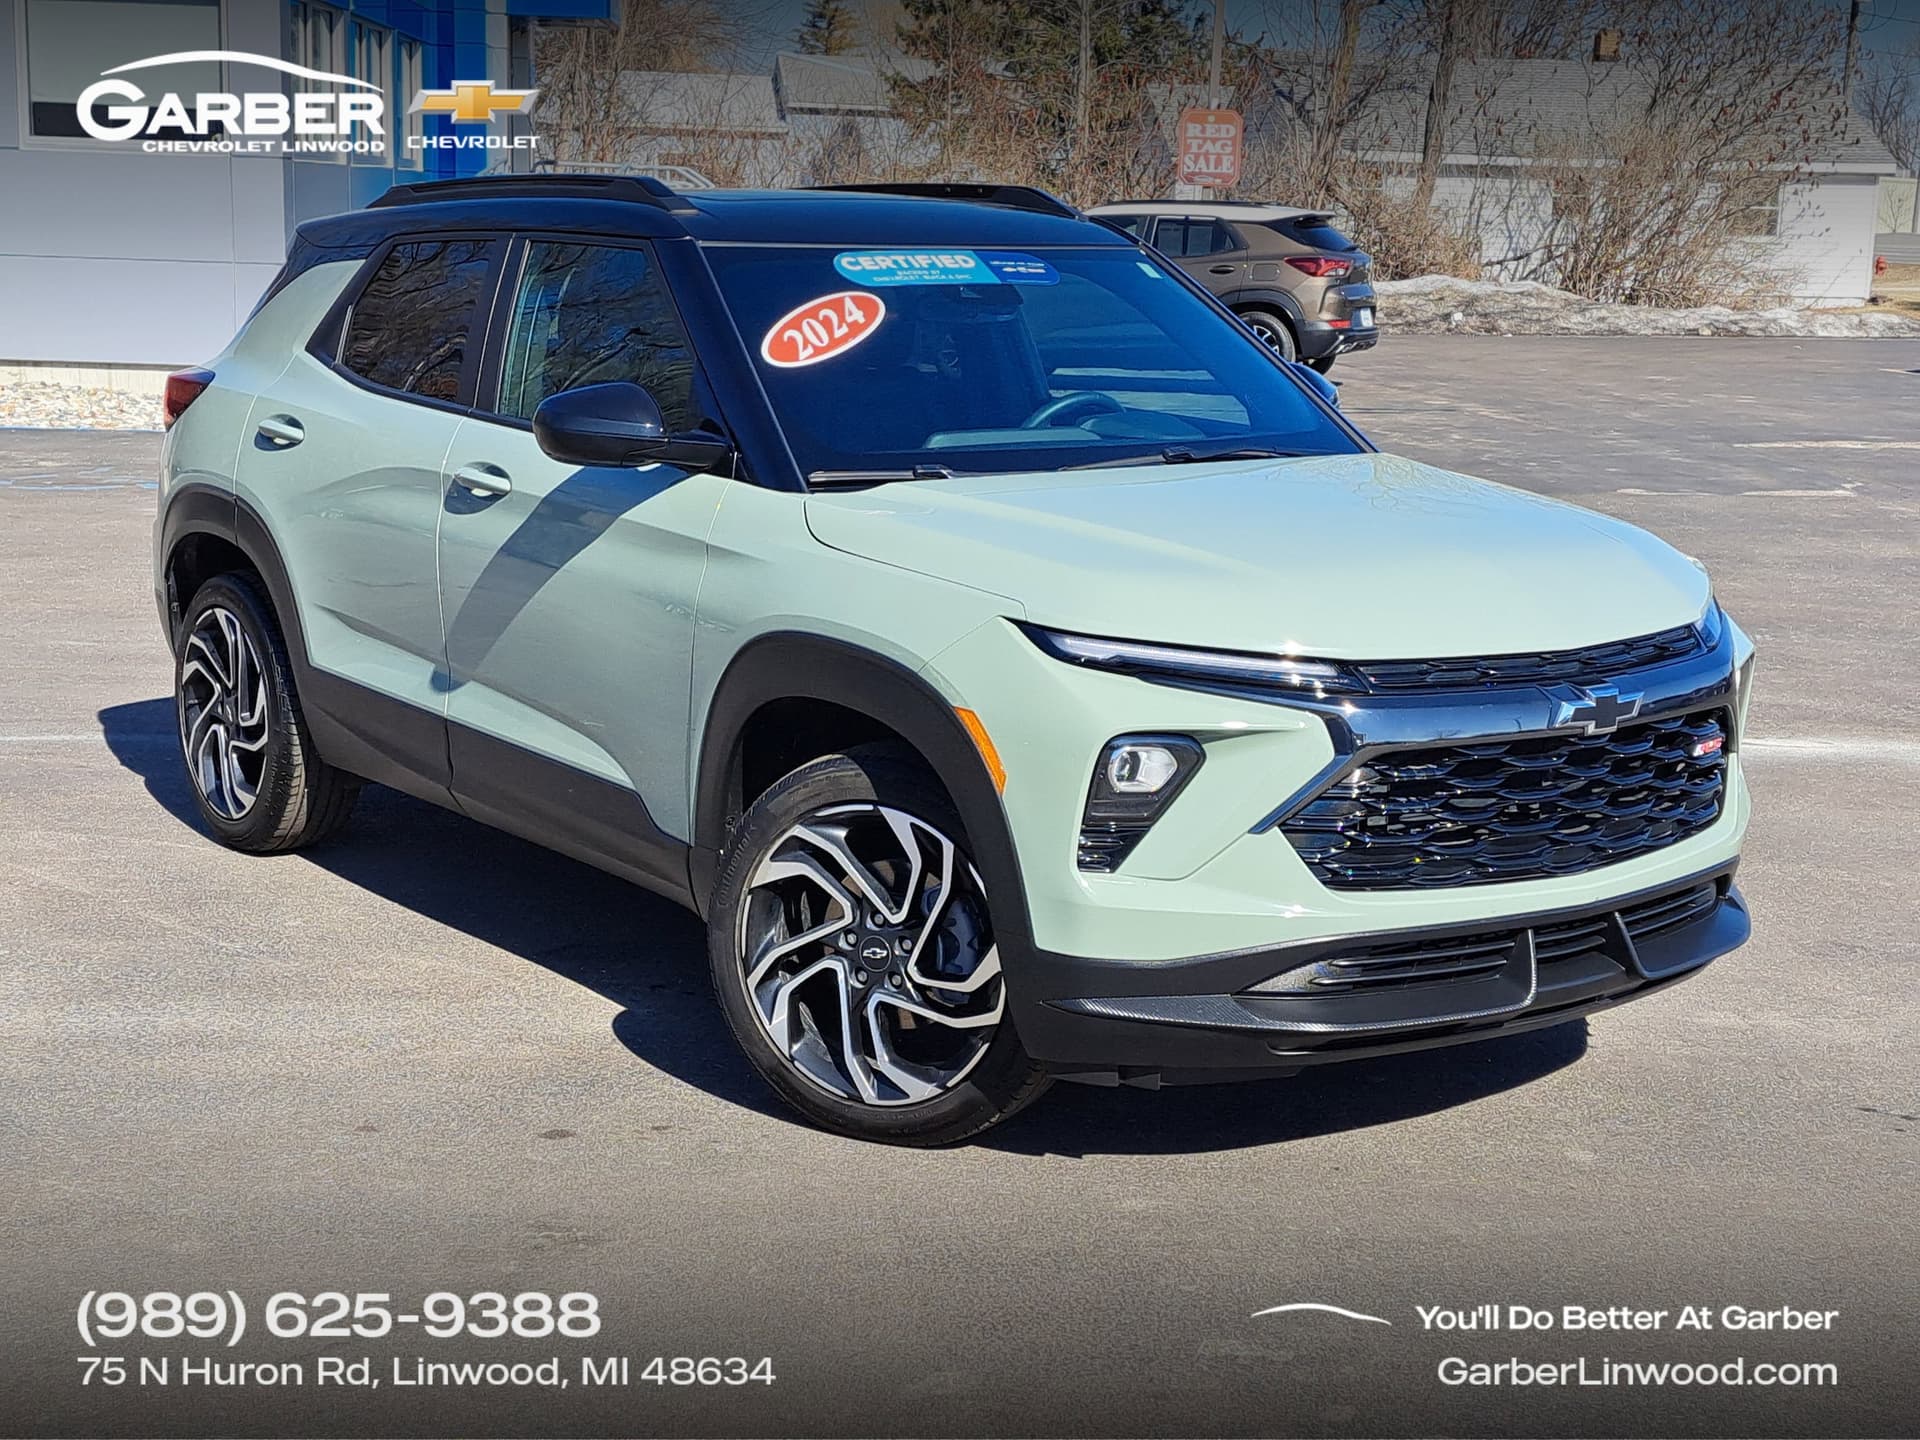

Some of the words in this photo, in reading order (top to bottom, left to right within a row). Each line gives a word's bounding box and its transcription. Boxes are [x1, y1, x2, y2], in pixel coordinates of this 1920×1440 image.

[1186, 124, 1236, 137] RED
[1187, 139, 1232, 153] TAG
[1183, 154, 1234, 173] SALE
[840, 254, 976, 271] CERTIFIED
[784, 296, 866, 360] 2024
